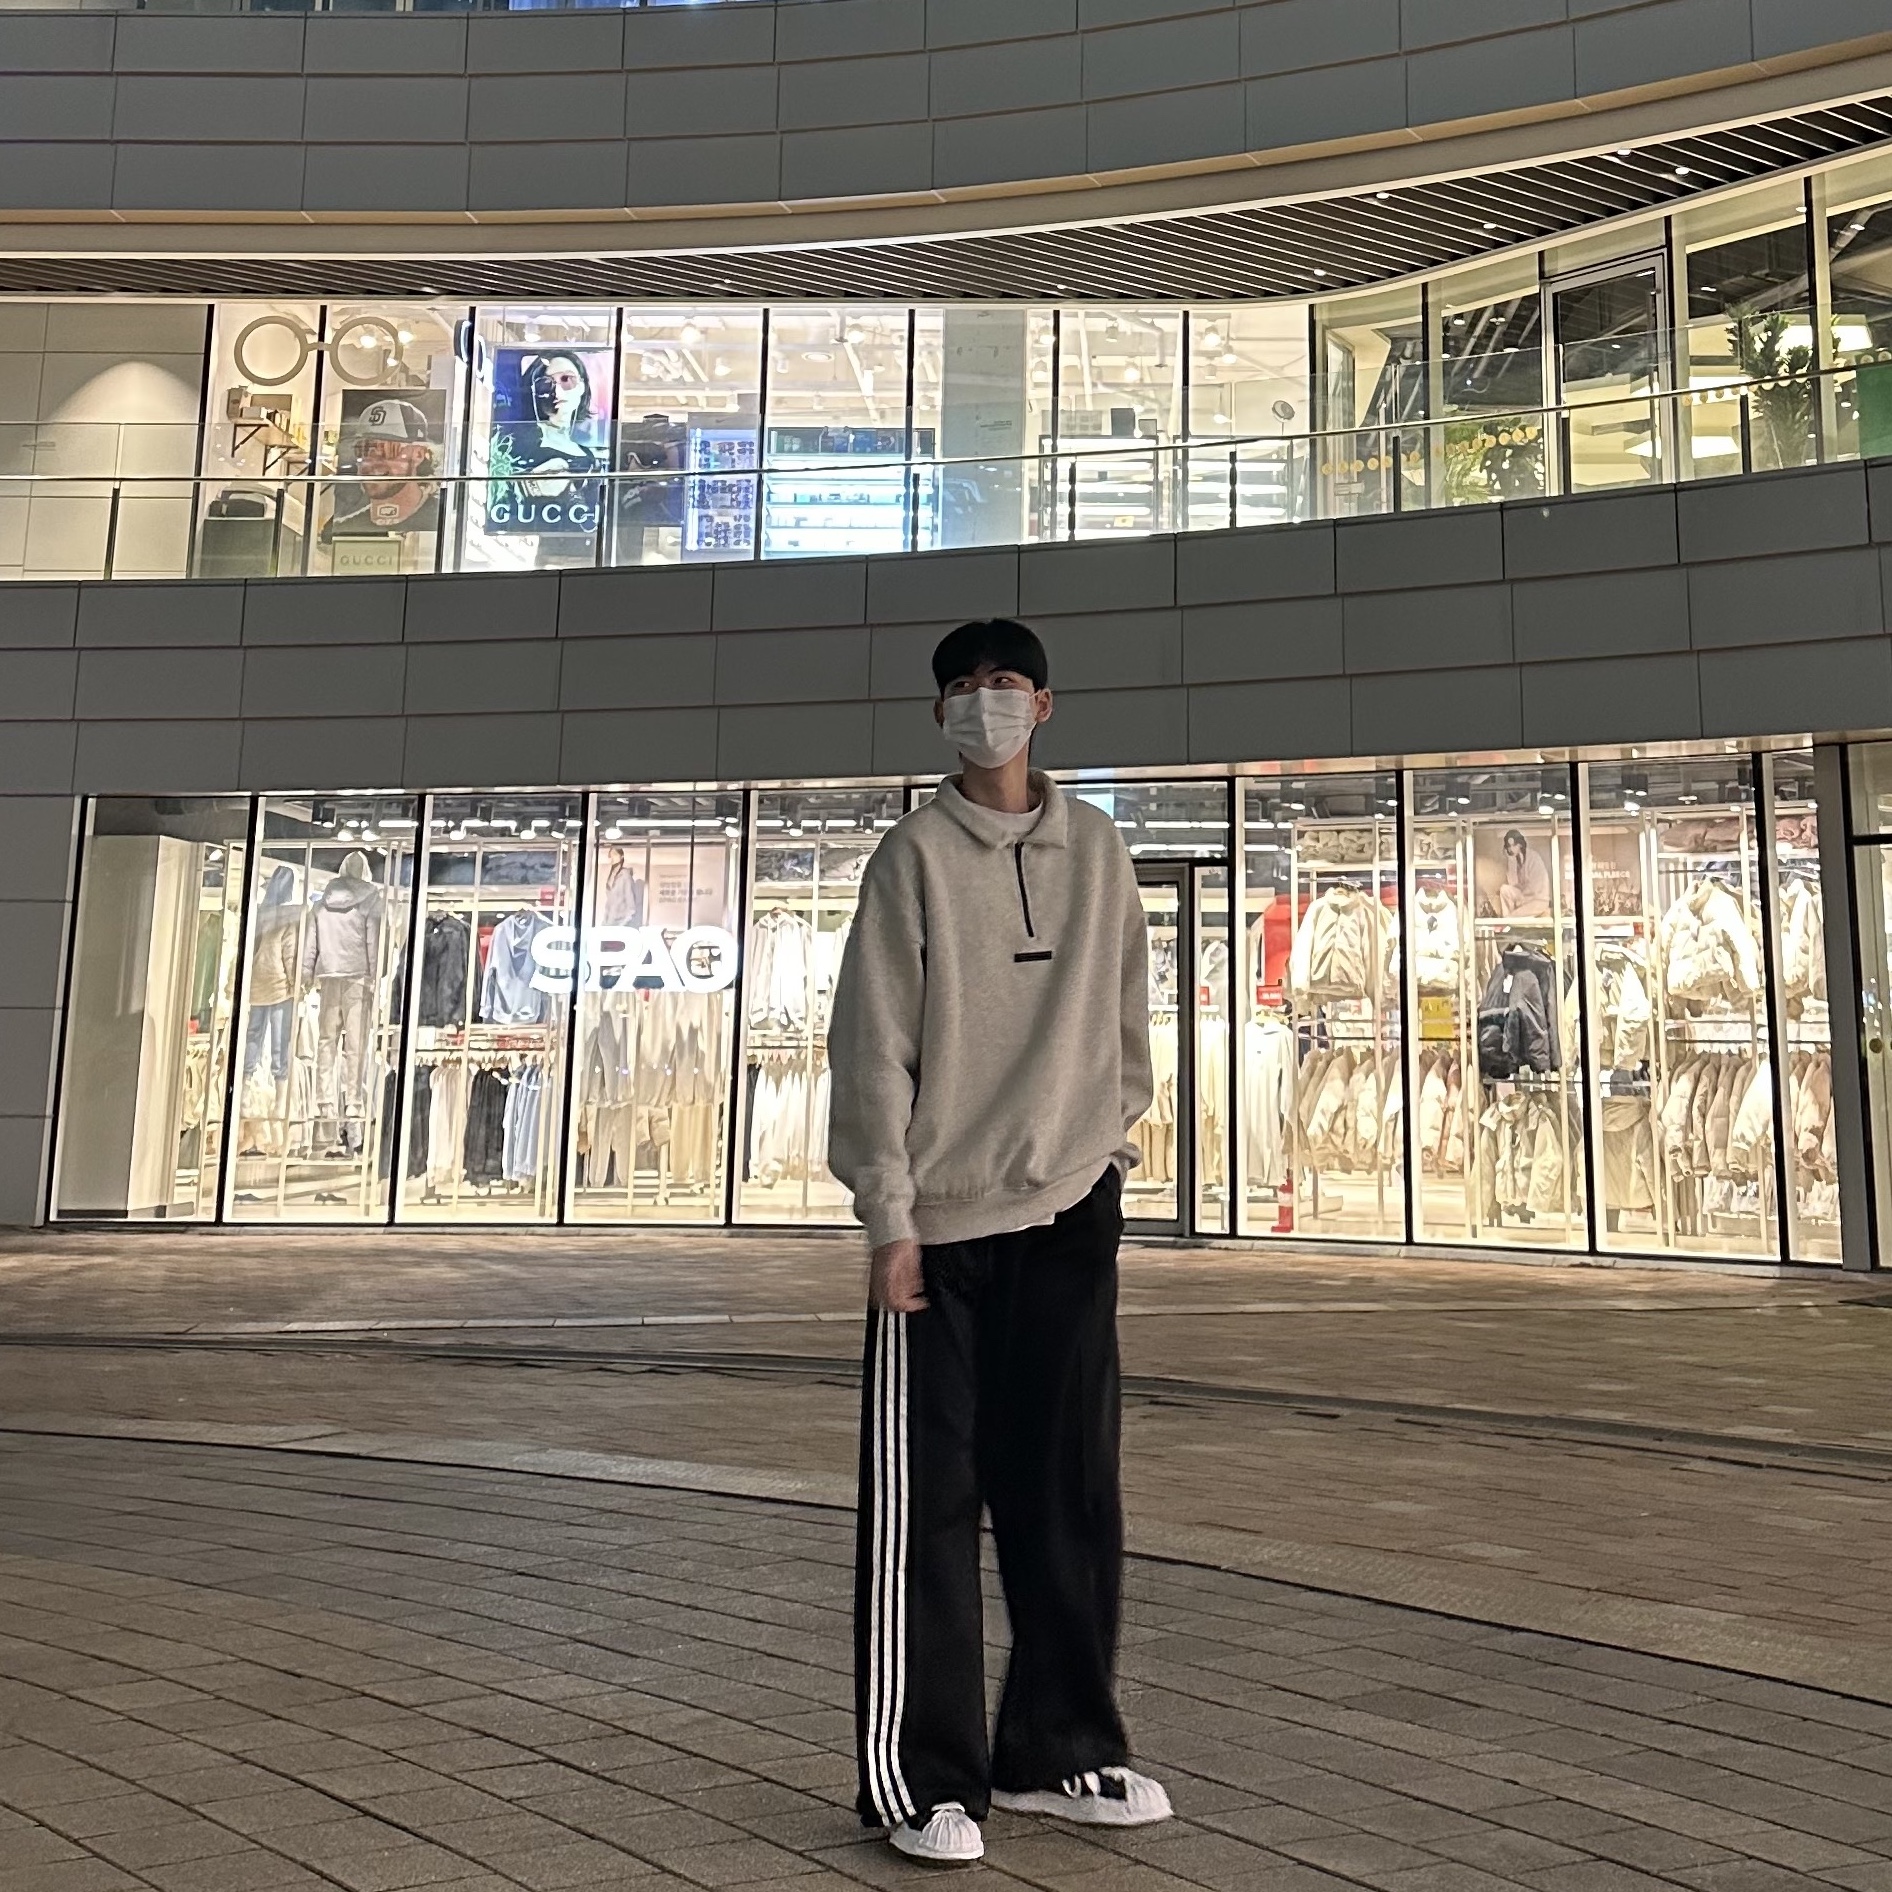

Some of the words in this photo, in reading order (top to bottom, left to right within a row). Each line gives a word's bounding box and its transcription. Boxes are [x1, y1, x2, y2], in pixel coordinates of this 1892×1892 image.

[490, 503, 600, 524] GUCCI
[340, 555, 393, 566] GUCCI
[529, 925, 737, 994] SPAO
